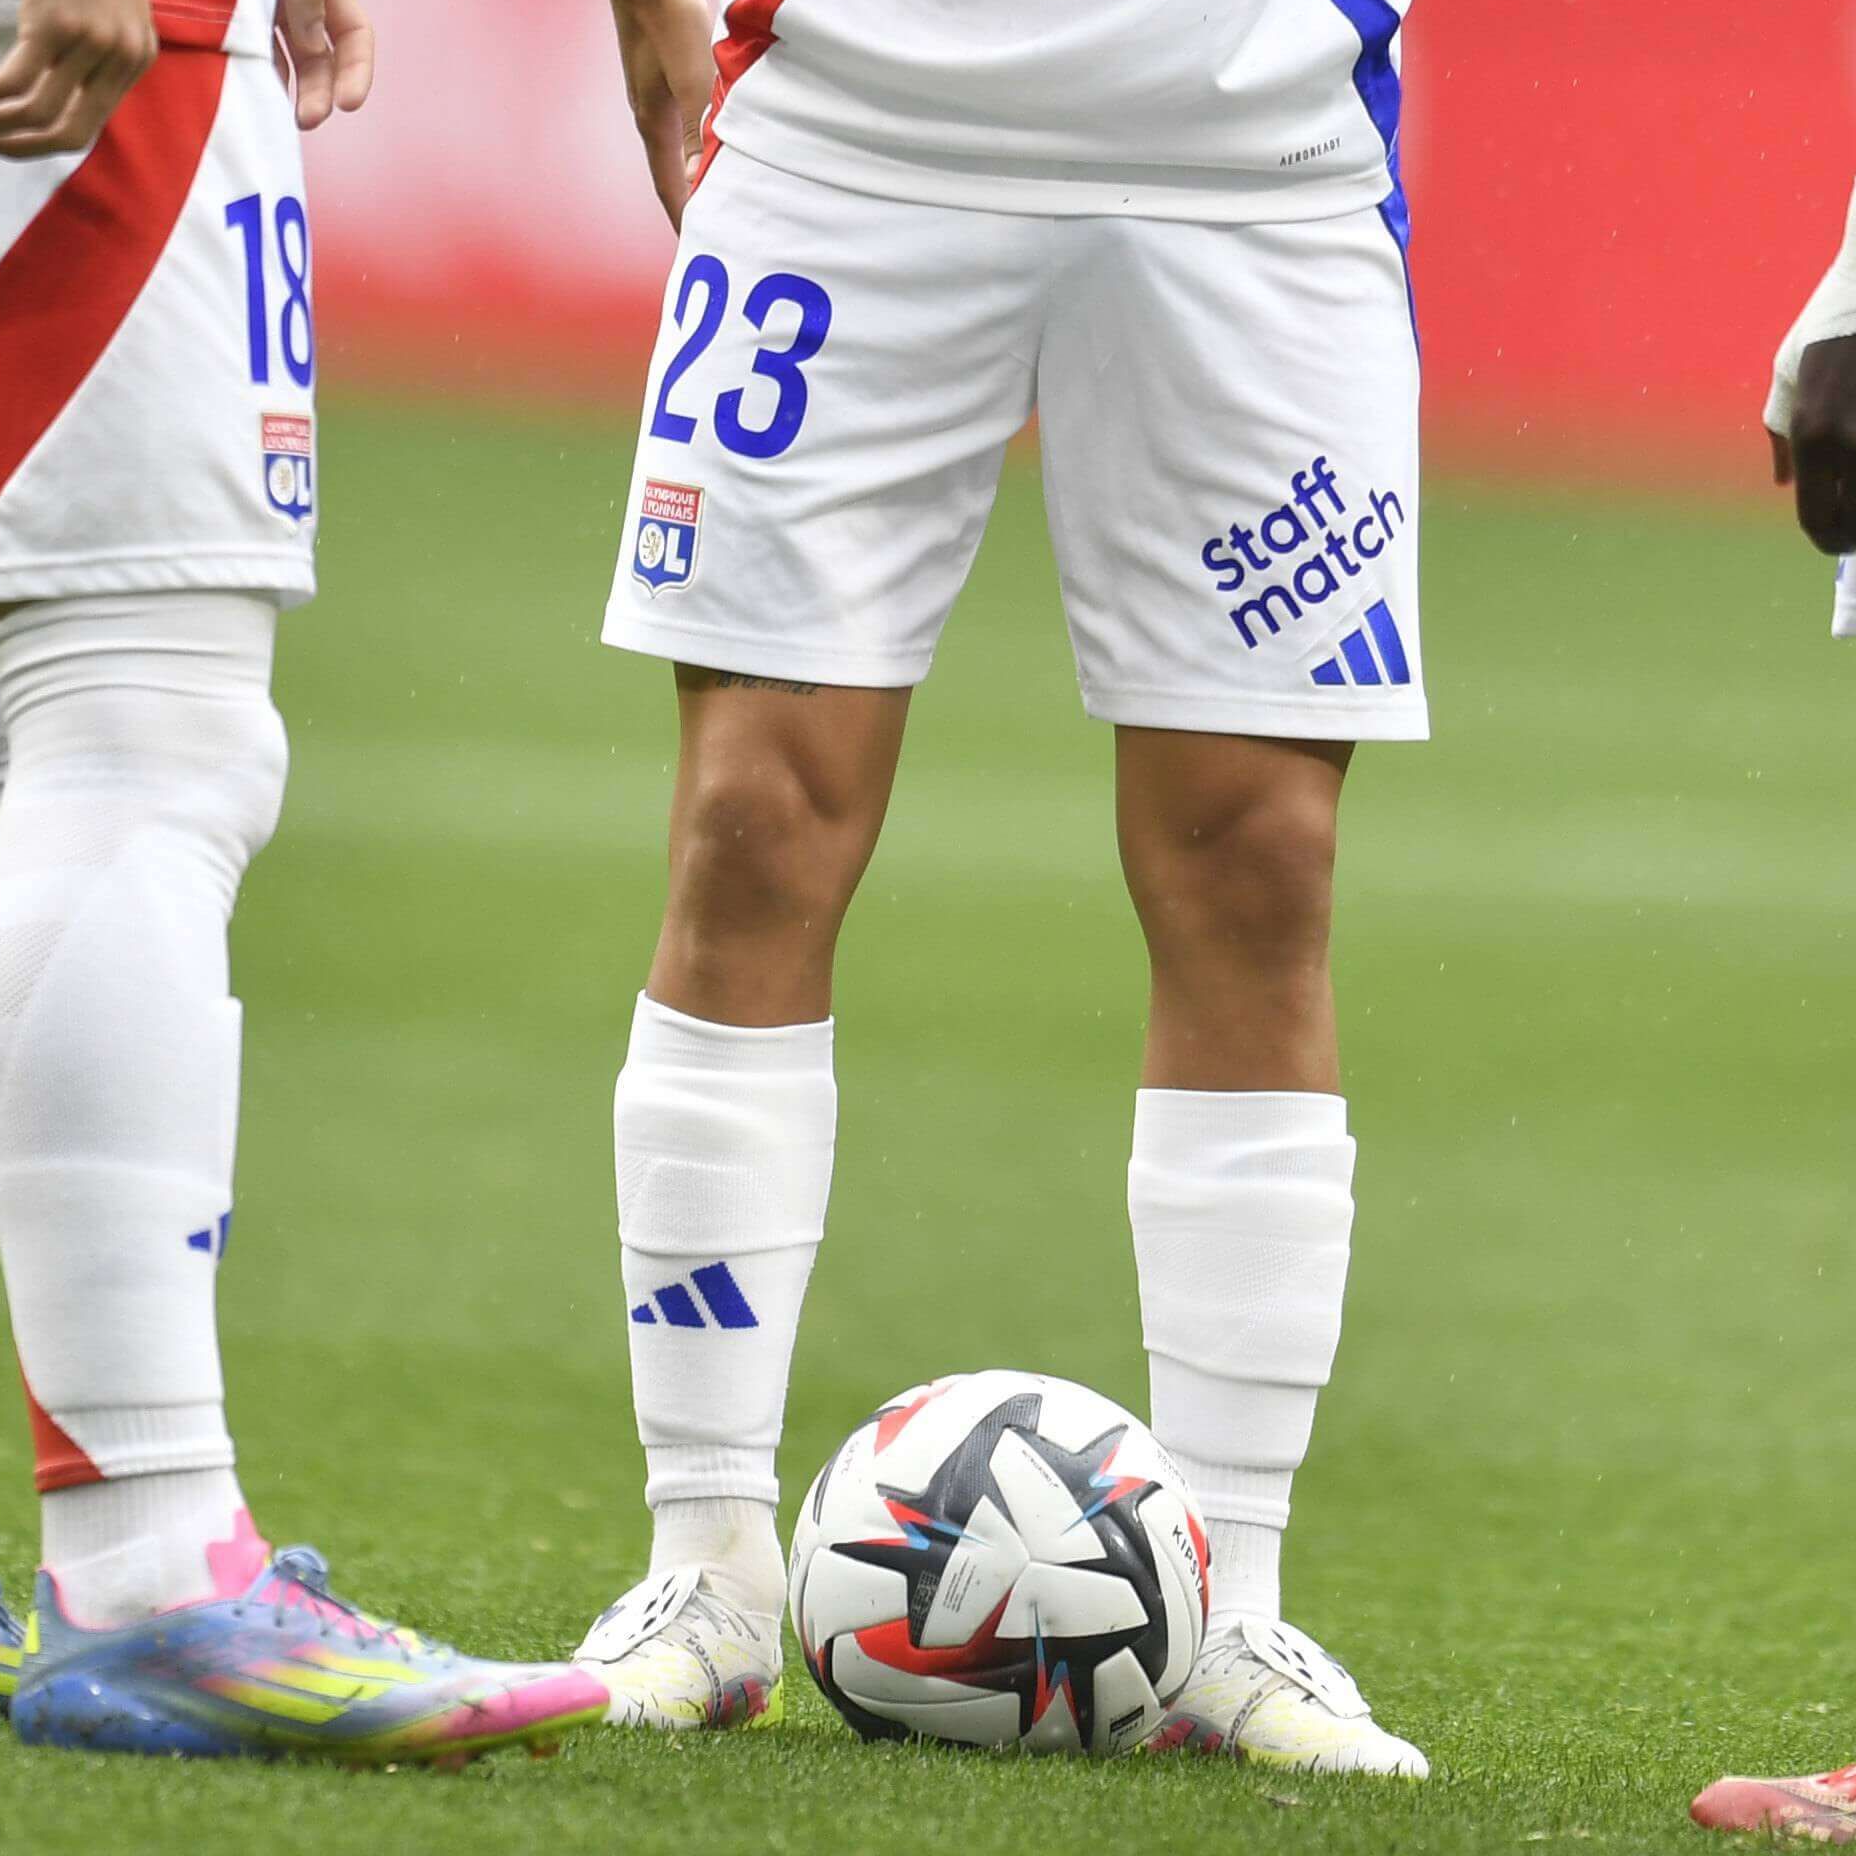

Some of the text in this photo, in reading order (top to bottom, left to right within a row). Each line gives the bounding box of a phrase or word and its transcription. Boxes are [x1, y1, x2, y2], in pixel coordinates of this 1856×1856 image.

[1279, 136, 1341, 167] AEROREADY
[224, 193, 313, 387] 18
[650, 254, 833, 459] 23
[1201, 455, 1346, 592] Staff
[1229, 488, 1405, 650] match
